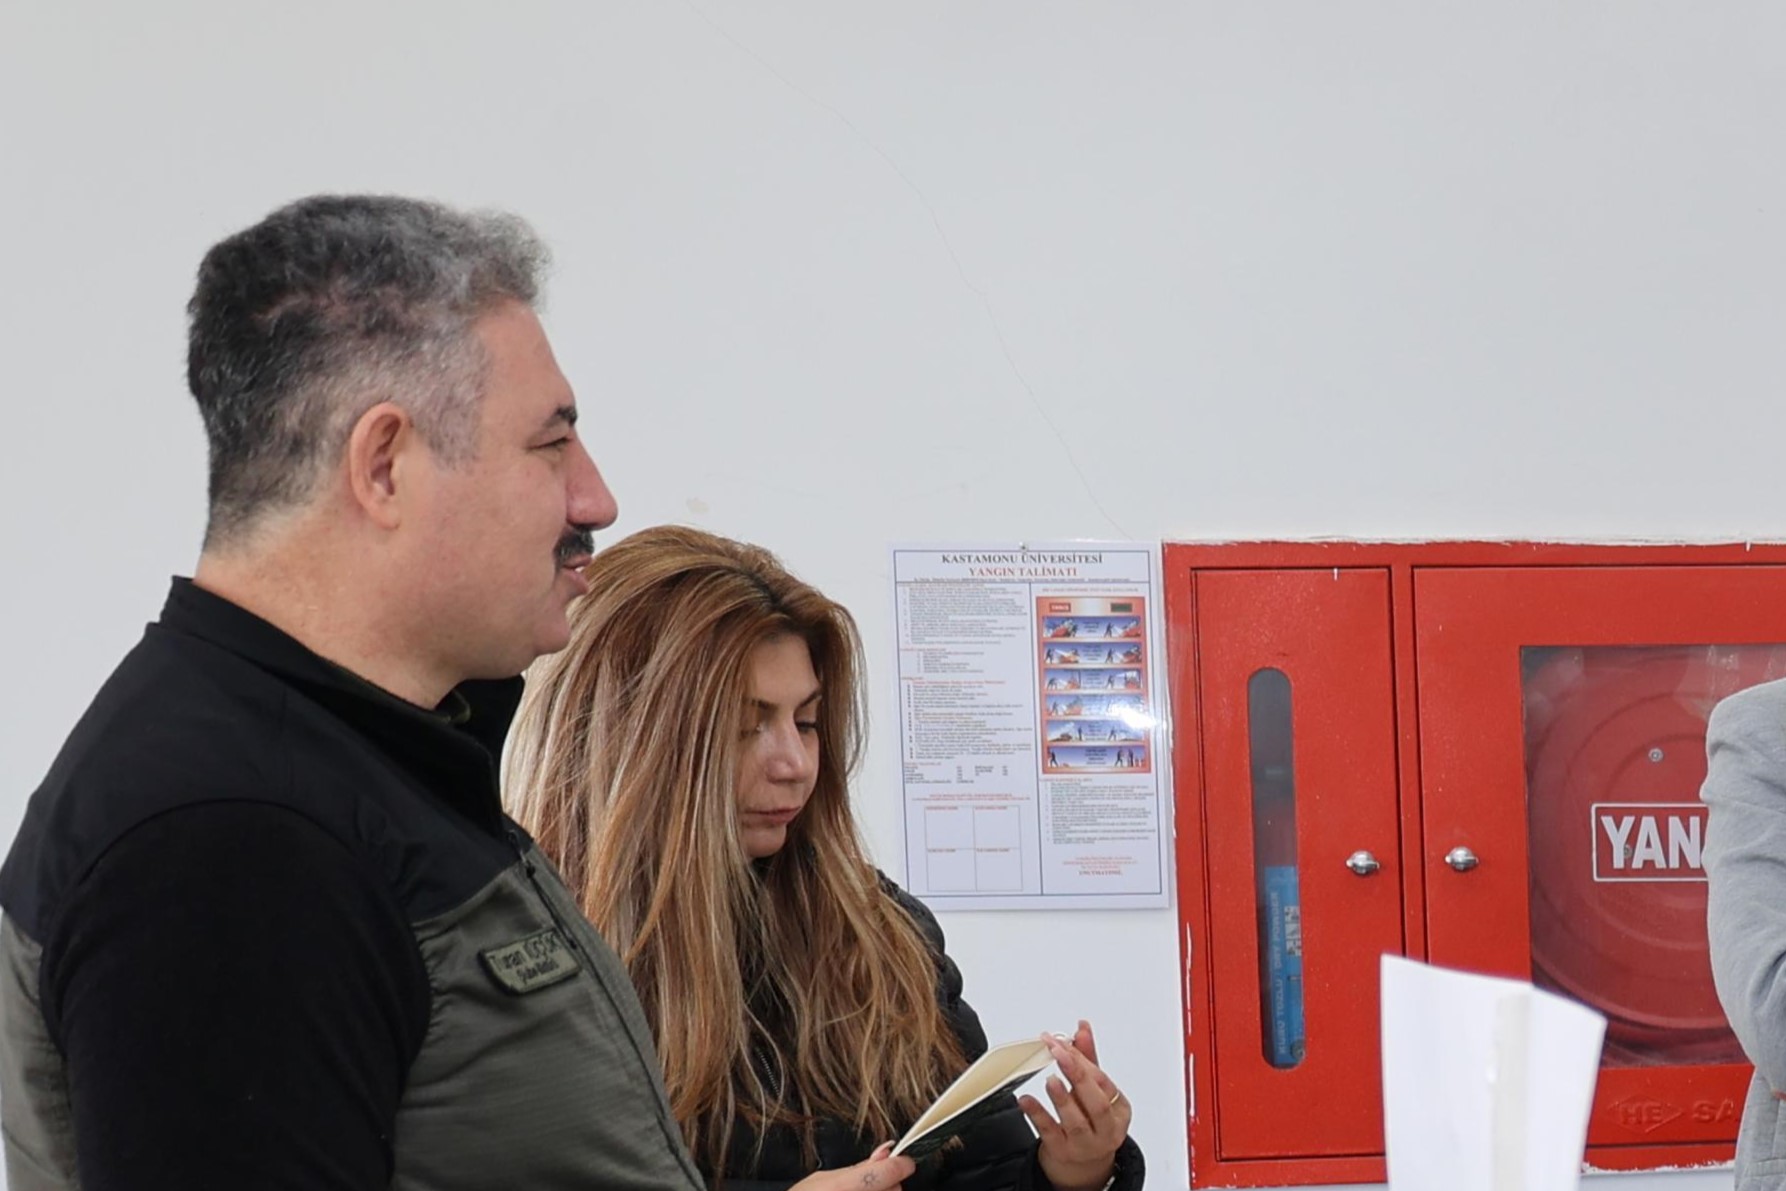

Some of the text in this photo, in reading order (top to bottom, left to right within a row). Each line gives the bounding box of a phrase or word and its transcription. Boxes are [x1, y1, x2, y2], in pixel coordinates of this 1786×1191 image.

[942, 552, 1103, 564] KASTAMONU ÜNİVERSİTESİ
[969, 566, 1077, 577] YANGIN TALİMATI
[1600, 815, 1706, 869] YAN
